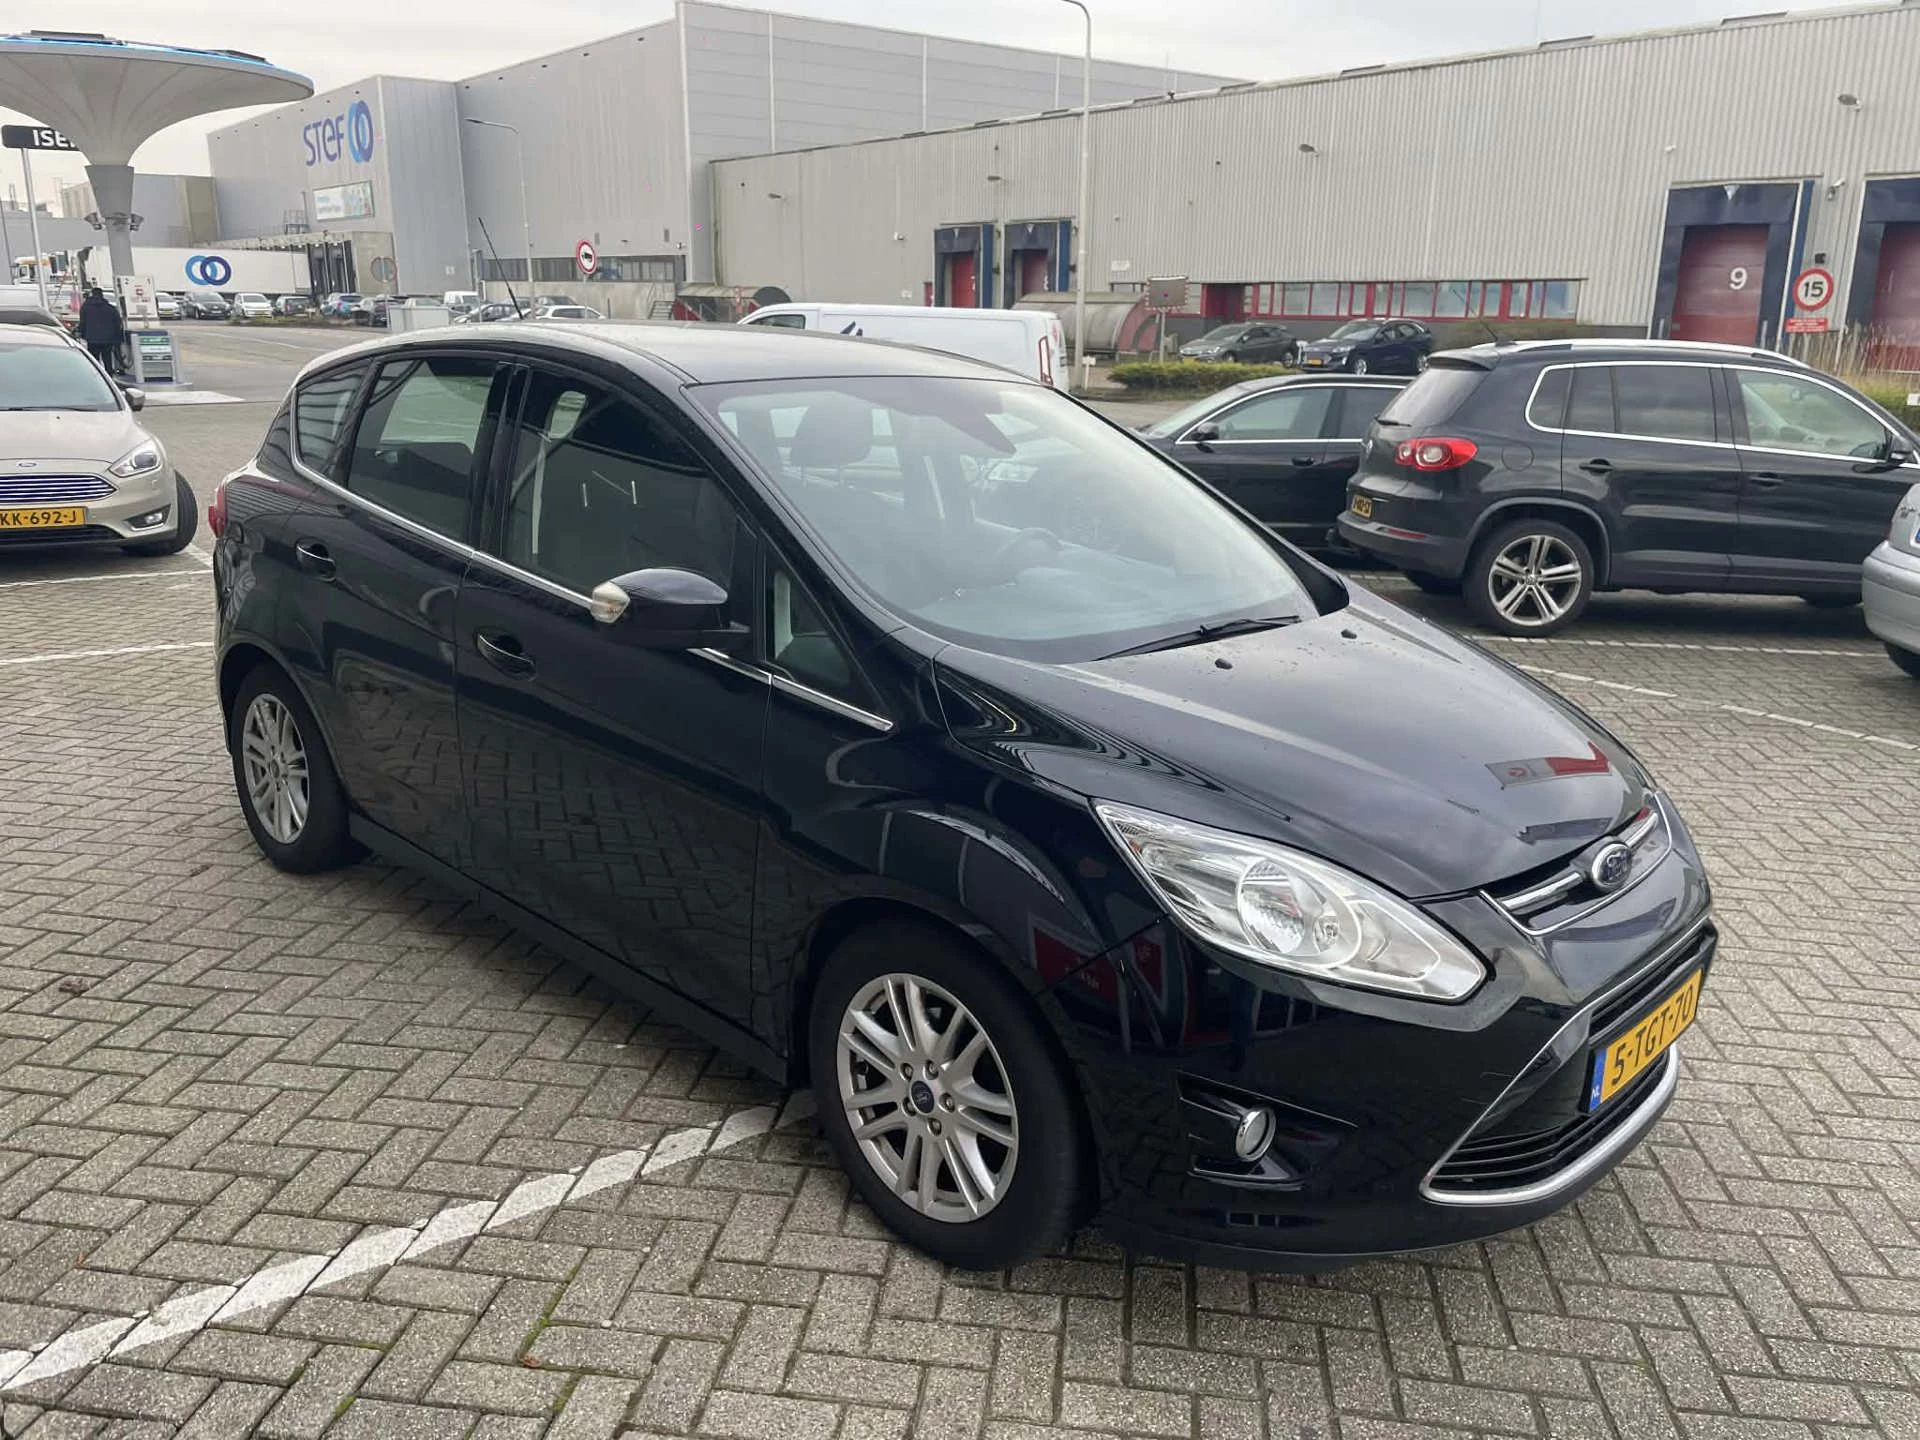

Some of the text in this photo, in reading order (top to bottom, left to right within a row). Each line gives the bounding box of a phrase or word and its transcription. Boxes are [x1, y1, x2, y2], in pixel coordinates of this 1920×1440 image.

[32, 129, 76, 147] ISE
[1730, 267, 1747, 290] 9
[1804, 281, 1824, 297] 15
[0, 510, 77, 526] KK-692-J
[1611, 984, 1694, 1086] 5-TGT-70
